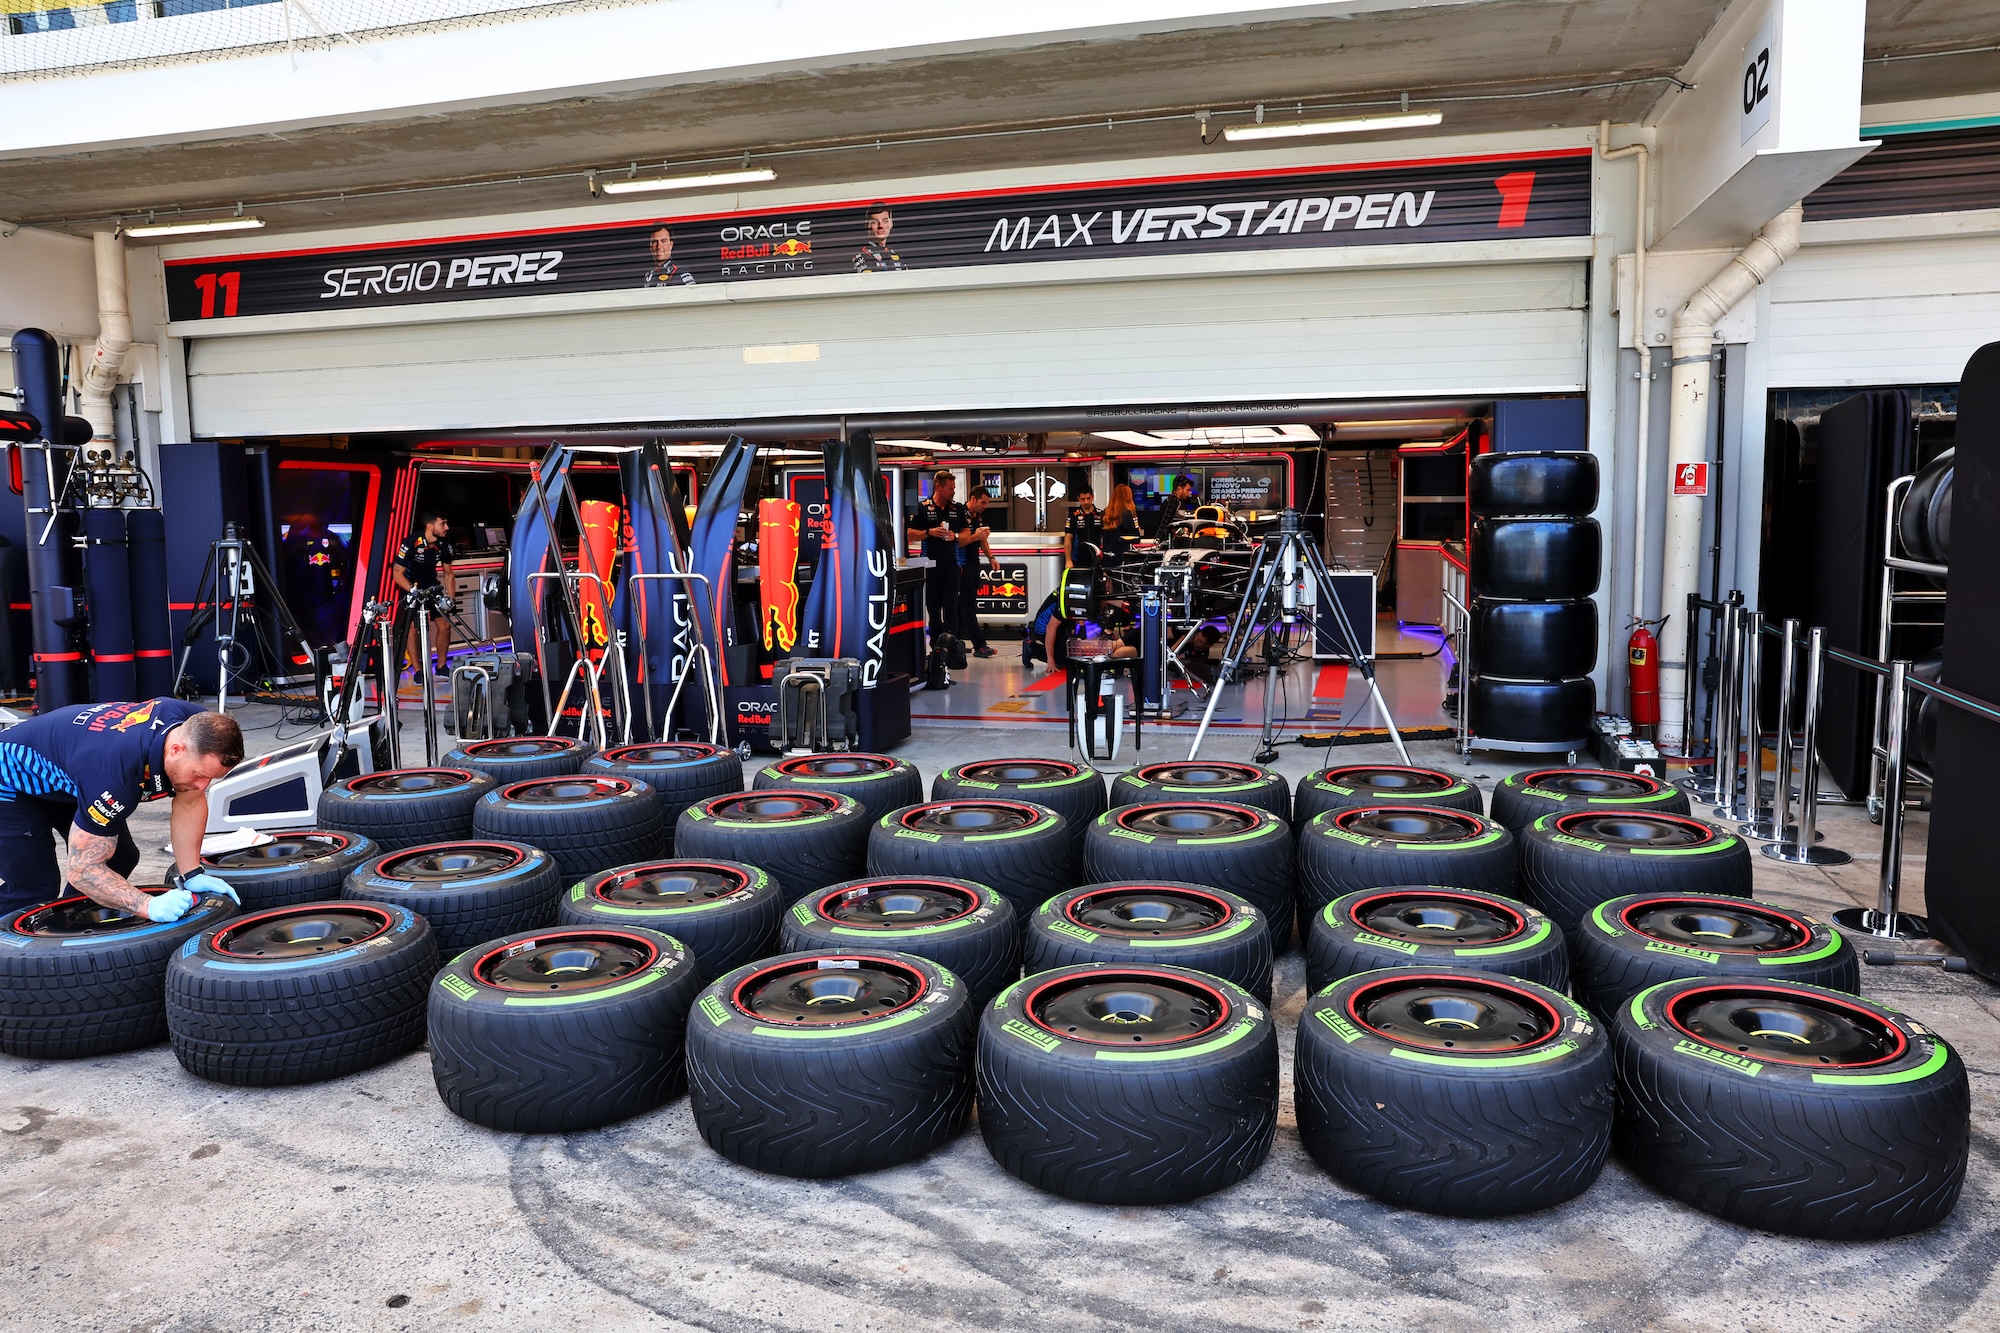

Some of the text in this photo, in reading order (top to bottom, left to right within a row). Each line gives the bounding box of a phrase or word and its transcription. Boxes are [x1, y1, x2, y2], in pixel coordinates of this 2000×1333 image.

[1743, 47, 1769, 115] 02
[1494, 171, 1536, 228] 1
[720, 220, 812, 242] ORACLE
[984, 191, 1435, 252] MAX VERSTAPPEN
[720, 243, 770, 260] Red Bull
[320, 250, 563, 299] SERGIO PEREZ
[721, 260, 813, 276] RACING
[194, 271, 241, 319] 11
[1086, 403, 1300, 417] @REDBULLRACING REDBULLRACING.COM
[647, 422, 737, 430] REDBULLRACING.COM
[980, 569, 1025, 582] ACLE
[976, 584, 989, 596] ull
[668, 546, 694, 684] RACLE
[976, 601, 1026, 609] CING
[863, 549, 889, 690] RACLE
[737, 701, 778, 713] ORAC
[154, 774, 162, 792] zoom
[100, 790, 125, 813] Mobil
[1047, 920, 1100, 944] PIRELLI
[1353, 932, 1420, 955] PIRELLI
[1645, 941, 1720, 964] PIRELLI
[439, 973, 480, 1001] PIRELLI
[698, 994, 732, 1027] PIRELLI
[1001, 1018, 1063, 1053] PIRELLI
[1314, 1007, 1364, 1043] PIRELLI
[1673, 1039, 1764, 1077] PIRELLI
